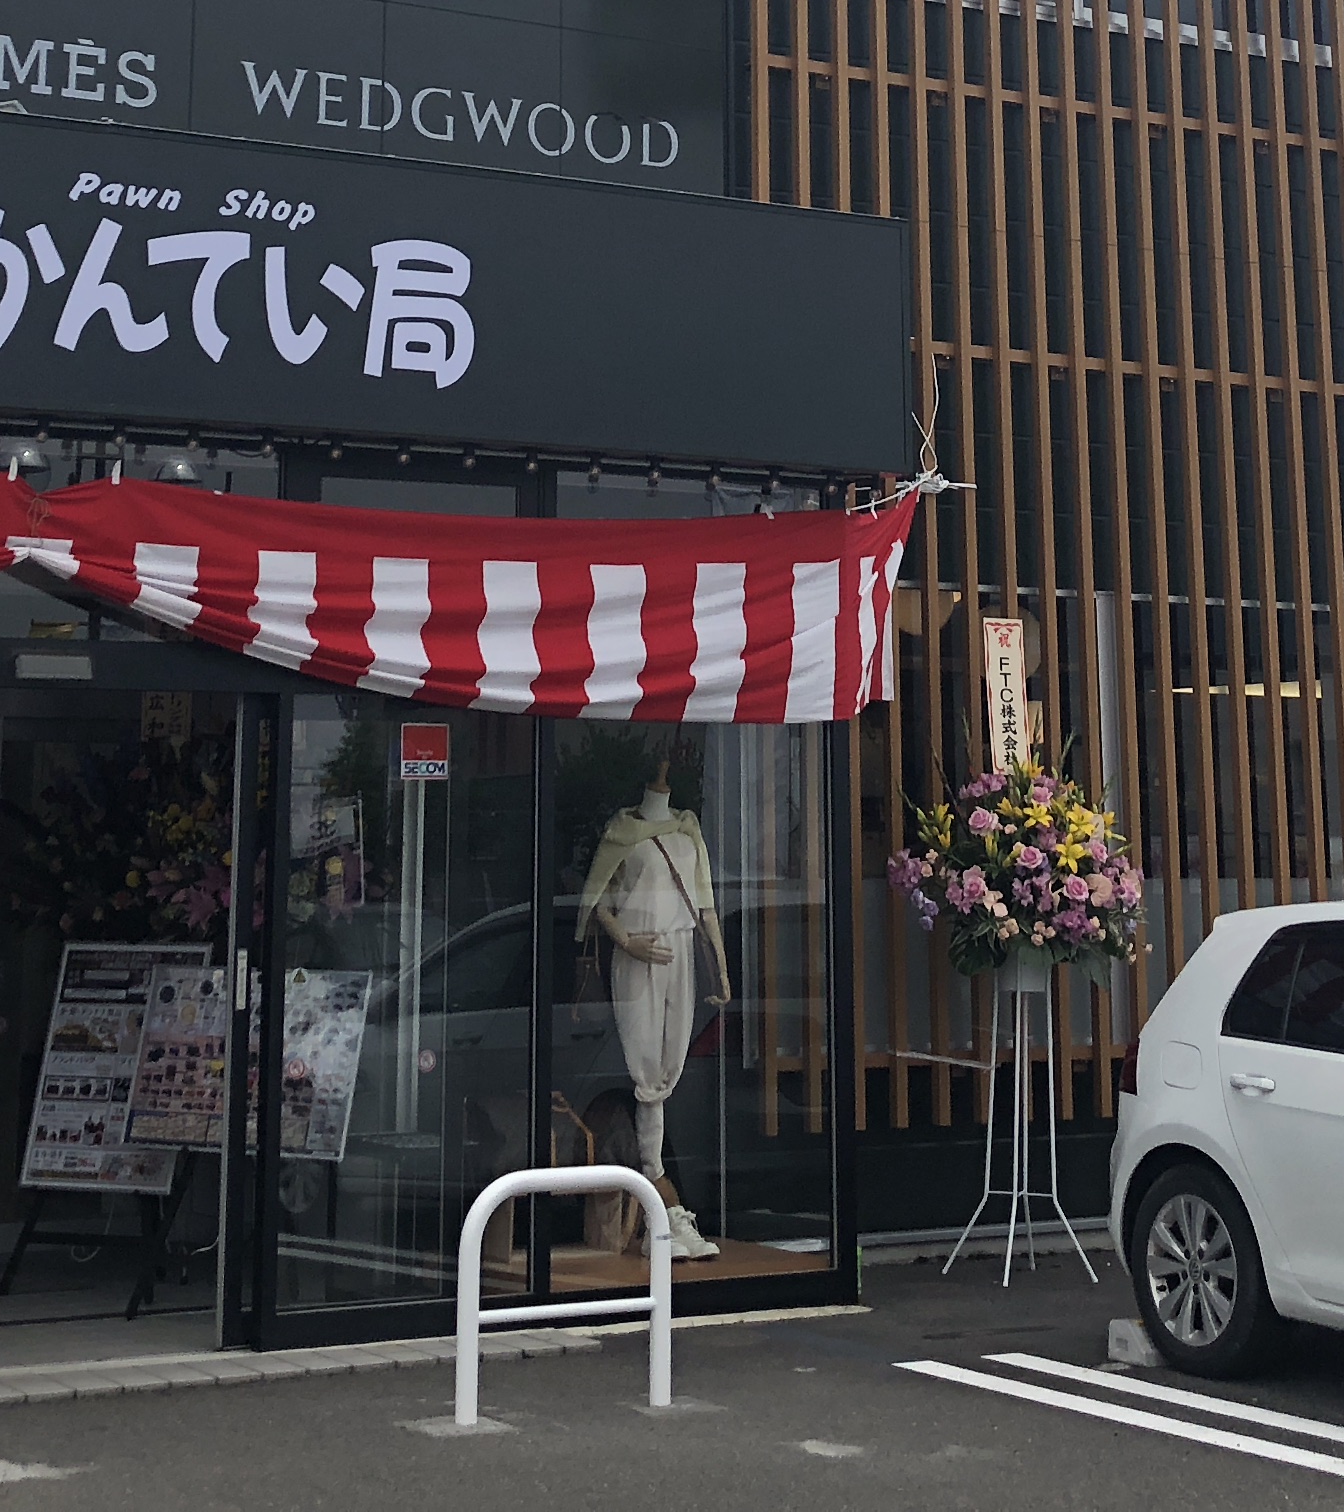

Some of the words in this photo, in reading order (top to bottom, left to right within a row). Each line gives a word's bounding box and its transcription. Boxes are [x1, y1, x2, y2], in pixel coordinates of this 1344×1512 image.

[240, 60, 680, 168] WEDGWOOD
[68, 172, 182, 212] Pawn
[218, 188, 317, 230] Shop
[997, 632, 1012, 648] 祝
[404, 762, 446, 774] SECOM
